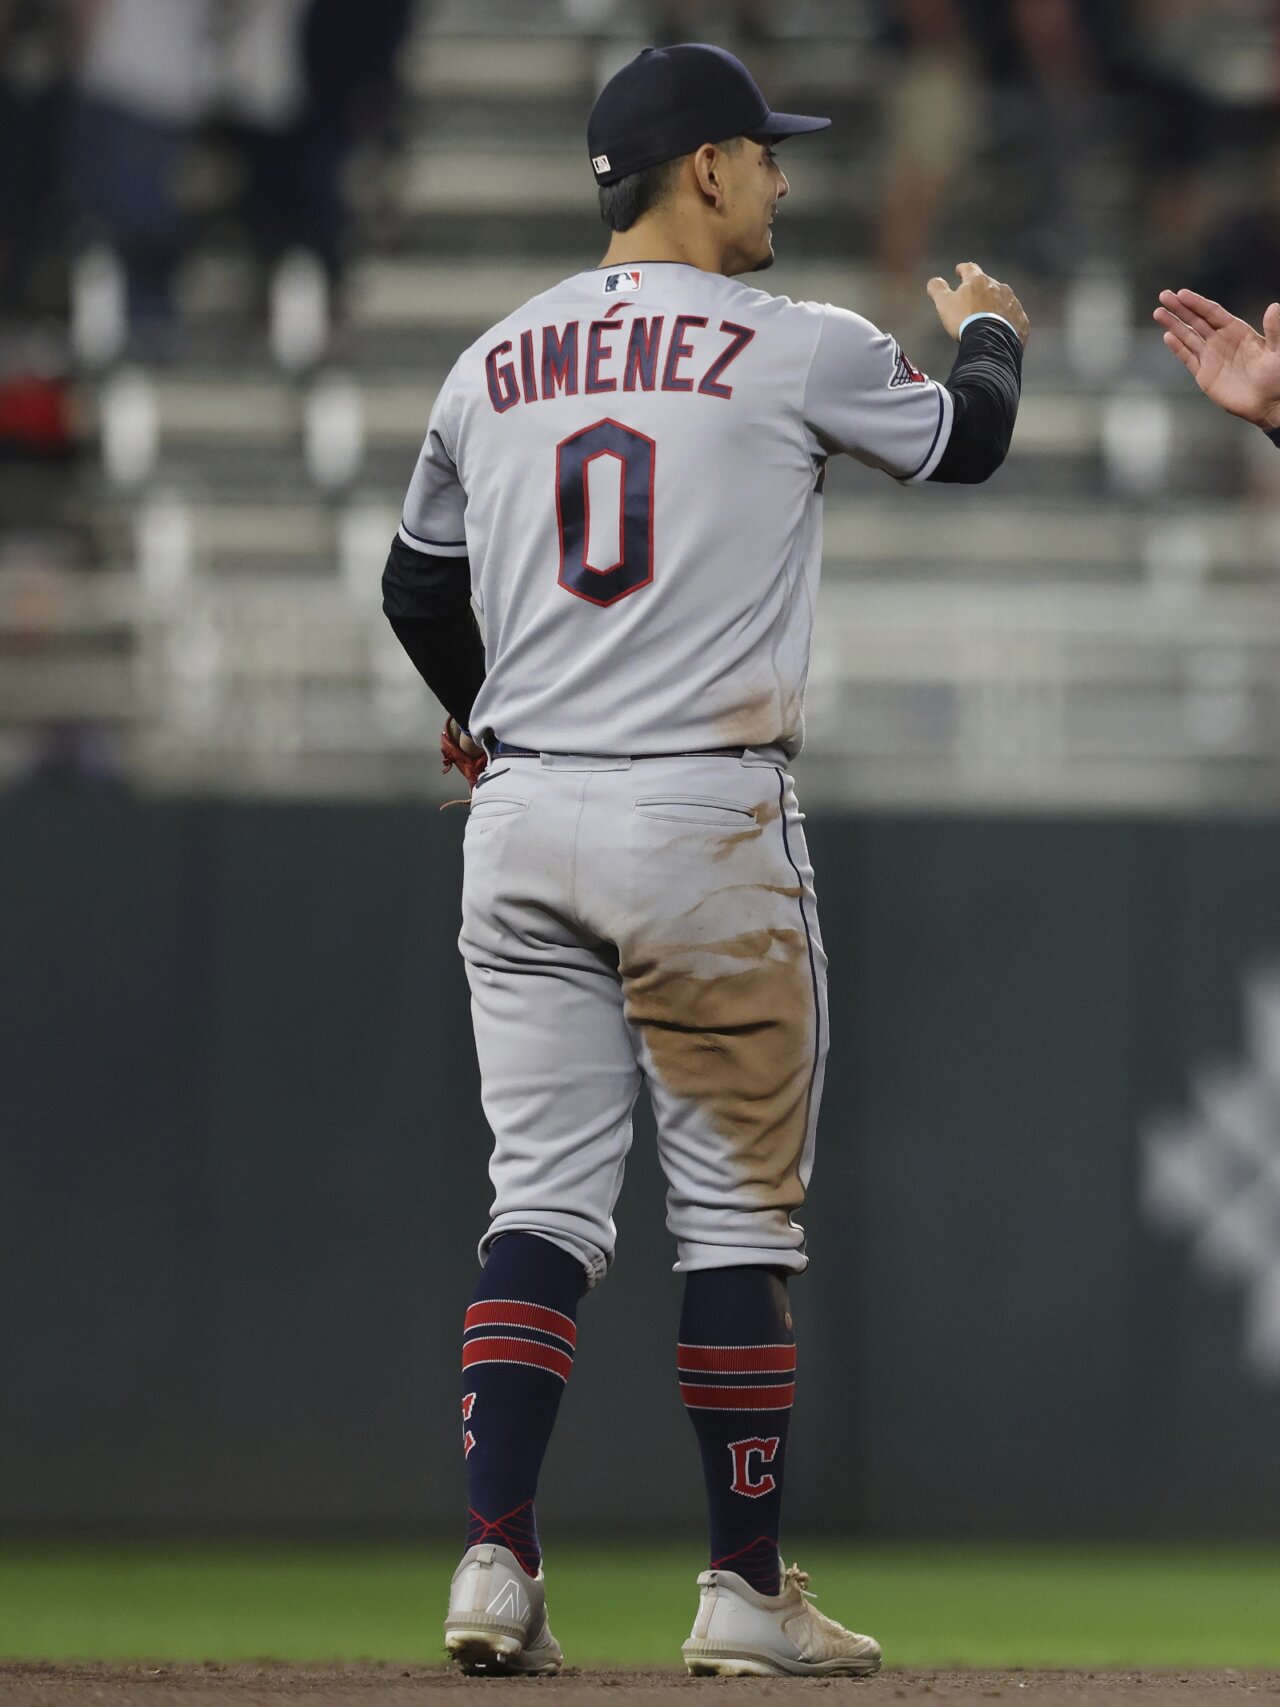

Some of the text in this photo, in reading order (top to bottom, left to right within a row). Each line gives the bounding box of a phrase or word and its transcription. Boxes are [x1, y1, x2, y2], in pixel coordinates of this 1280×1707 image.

[485, 301, 755, 413] GIMÉNEZ
[555, 417, 656, 608] 0
[727, 1436, 780, 1499] C
